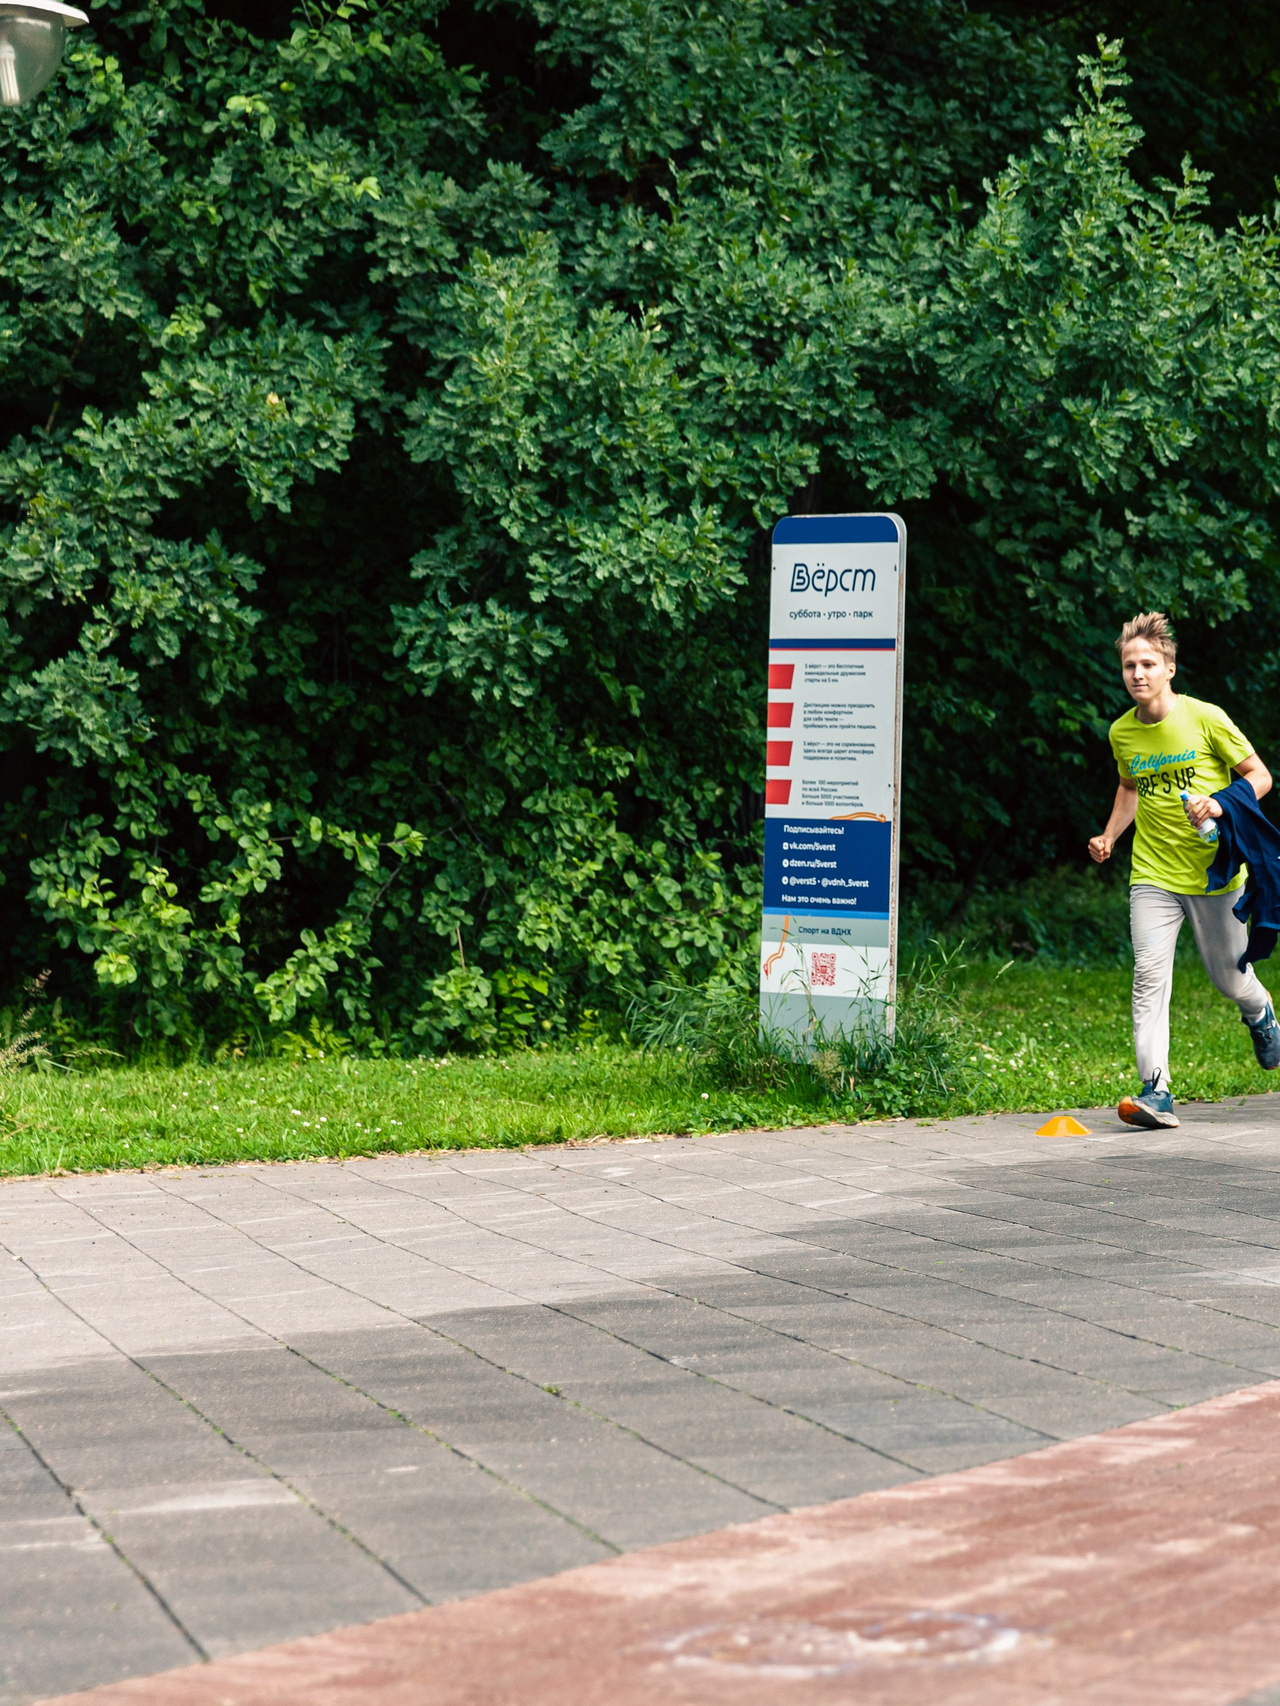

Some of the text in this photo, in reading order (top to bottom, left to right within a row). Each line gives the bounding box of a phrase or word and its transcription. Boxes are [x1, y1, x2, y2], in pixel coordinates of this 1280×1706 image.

[790, 609, 873, 620] суббота утро парк
[1131, 749, 1196, 776] California
[1174, 767, 1195, 790] UP
[784, 824, 844, 835] Подписывайтесь!
[789, 842, 836, 851] vk.com/5verst
[789, 859, 837, 868] dzen.ru/5verst
[798, 926, 819, 935] Спорт
[831, 928, 852, 936] ВДНХ
